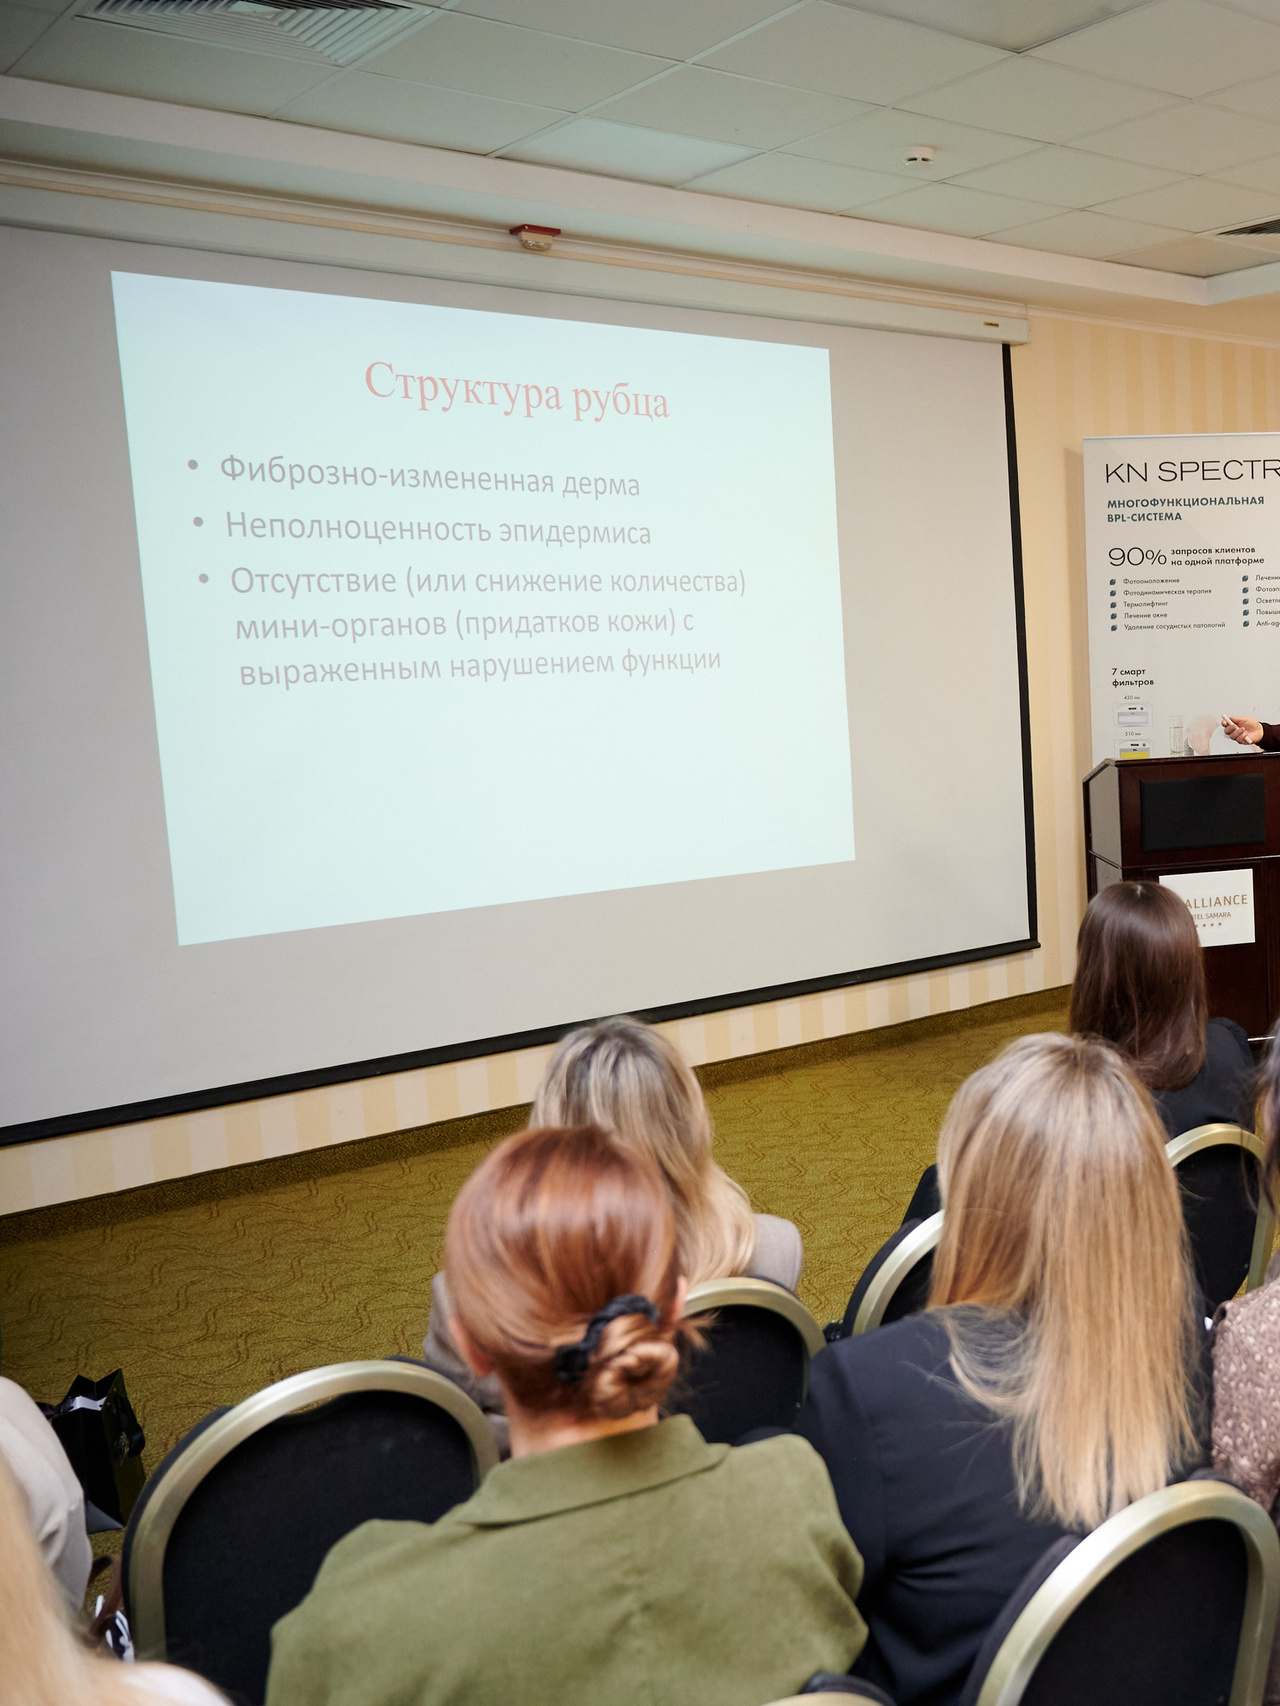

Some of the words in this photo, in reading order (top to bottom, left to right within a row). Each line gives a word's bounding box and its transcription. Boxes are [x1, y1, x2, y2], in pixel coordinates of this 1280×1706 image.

[364, 360, 563, 418] Структура
[572, 382, 671, 423] рубца
[220, 454, 555, 494] Фиброзно-измененная
[562, 473, 641, 498] дерма
[1105, 462, 1148, 484] KN
[1107, 496, 1265, 509] МНОГОФУНКЦИОНАЛЬНАЯ
[1107, 512, 1183, 523] BPL-СИСТЕМА
[225, 510, 492, 546] Неполноценность
[498, 522, 653, 548] эпидермиса
[1108, 546, 1168, 567] 90%
[1170, 547, 1213, 557] запросов
[1214, 546, 1256, 554] клиентов
[1185, 556, 1213, 566] одной
[1214, 557, 1265, 566] платформе
[230, 565, 397, 600] Отсутствие
[405, 566, 467, 597] (или
[474, 570, 603, 595] снижение
[610, 569, 747, 597] количества)
[1123, 577, 1180, 585] Фотоомоложение
[1123, 589, 1185, 597] Фотодинамическая
[1186, 588, 1212, 596] терапия
[1124, 612, 1151, 620] Лечение
[235, 611, 447, 644] мини-органов
[455, 609, 600, 640] (придатков
[607, 608, 677, 636] кожи)
[683, 610, 695, 632] с
[1193, 621, 1226, 629] патологий
[239, 658, 442, 691] выраженным
[450, 652, 615, 681] нарушением
[621, 648, 722, 677] функции
[1112, 668, 1118, 676] 7
[1119, 668, 1146, 677] смарт
[1112, 678, 1155, 688] фильтров
[1185, 894, 1248, 909] ALLIANCE
[1205, 911, 1232, 920] SAMARA
